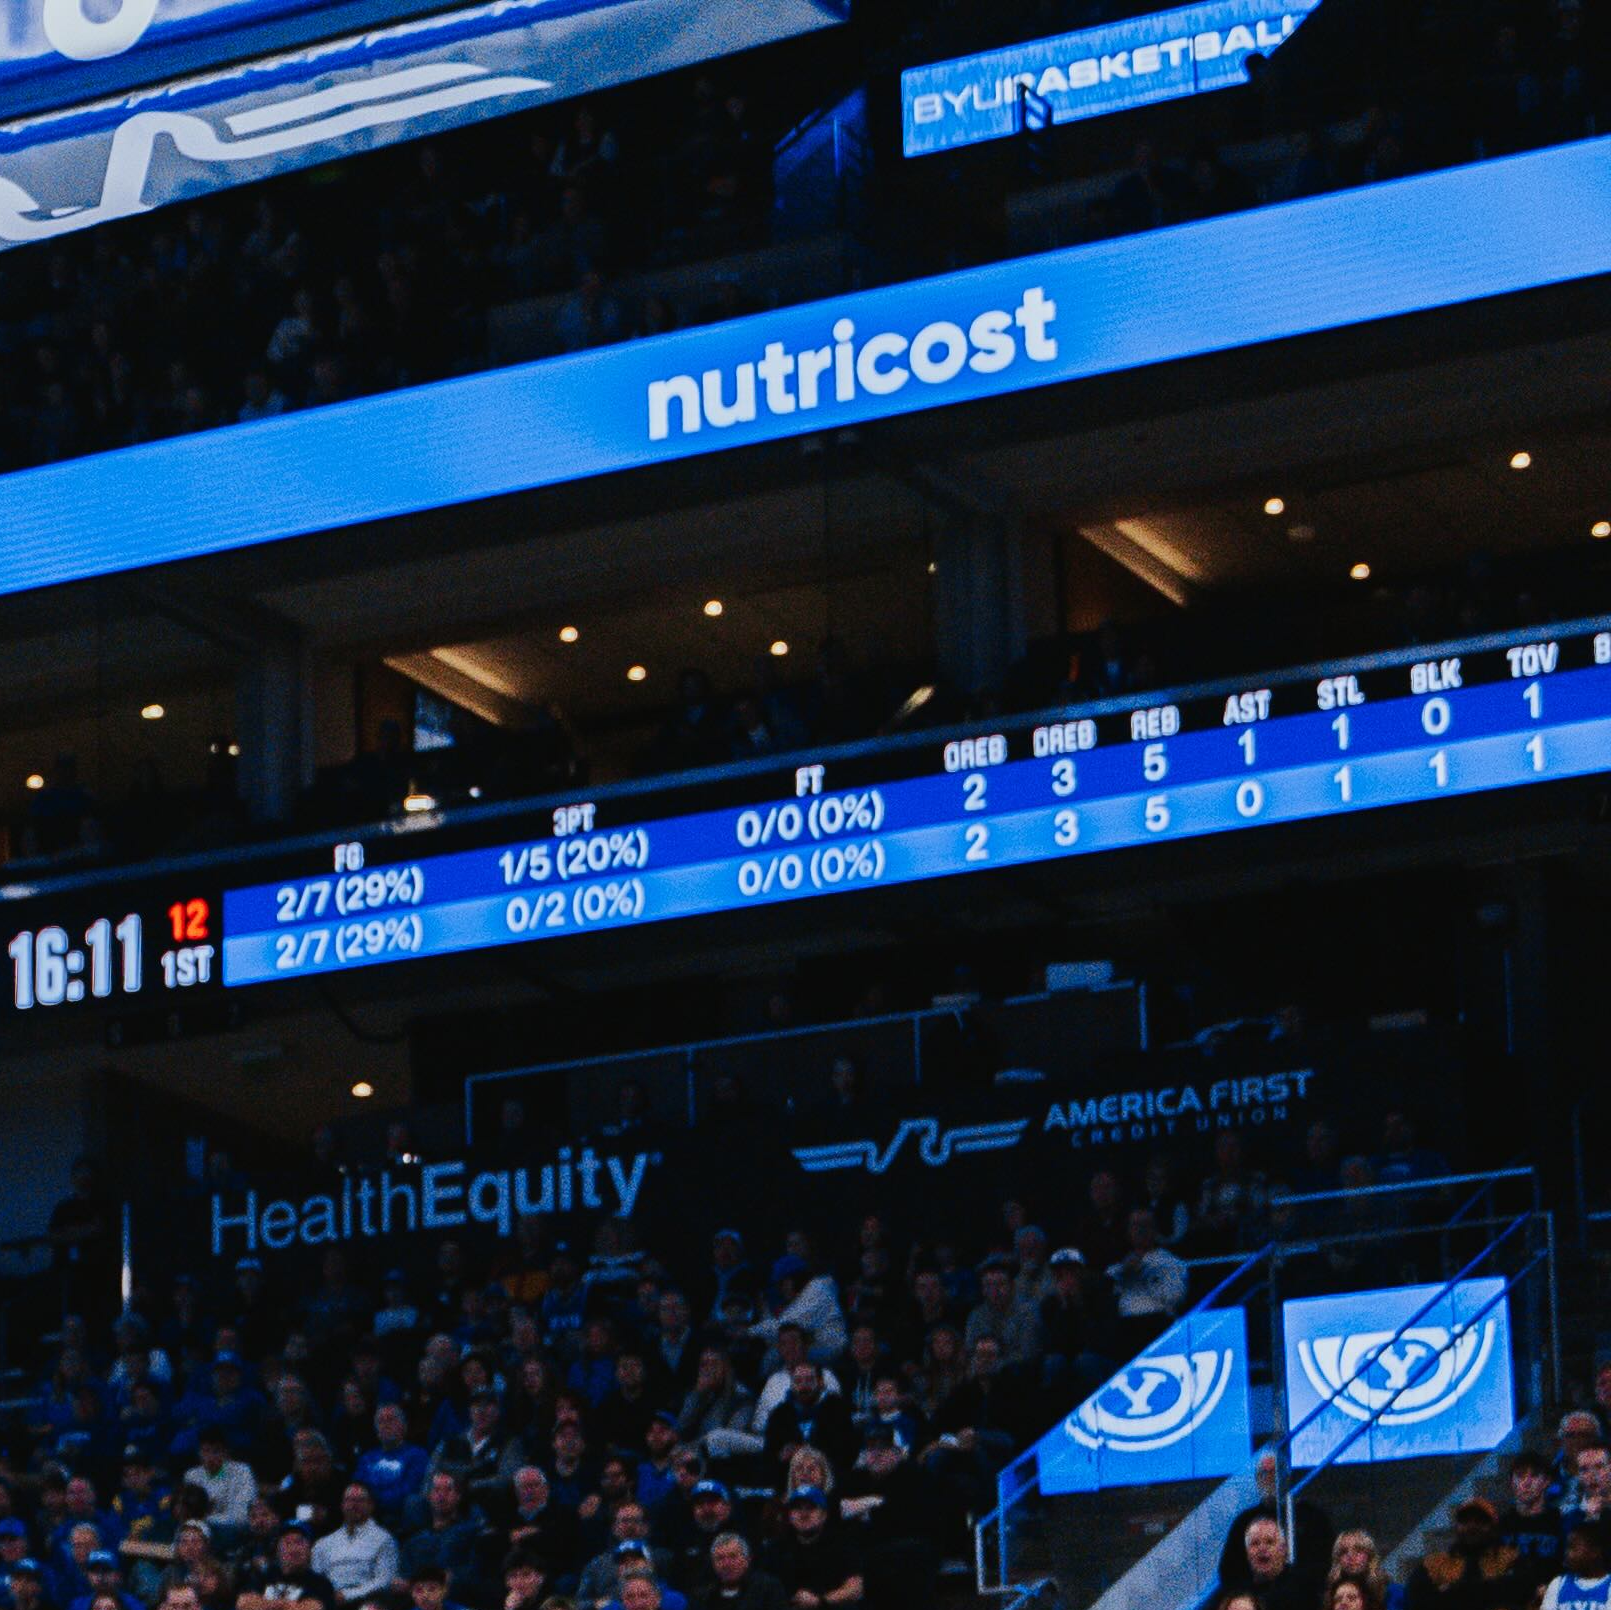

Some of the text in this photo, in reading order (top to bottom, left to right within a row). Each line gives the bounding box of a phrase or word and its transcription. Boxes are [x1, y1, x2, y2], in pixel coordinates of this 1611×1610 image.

[648, 287, 1057, 440] nutricost
[944, 735, 1007, 773] OREB
[1131, 705, 1179, 740] REB
[1223, 689, 1271, 726] AST
[1317, 676, 1365, 712] STL
[1410, 658, 1463, 695] BLK
[1506, 643, 1559, 680] TOV
[277, 682, 1542, 922] 2/7 (29%) 1/5 (20%) 0/0 (0%) 2 3 5 1 1 0 1
[796, 765, 825, 798] FT
[553, 803, 596, 836] 3PT
[276, 735, 1545, 970] 2/7 (29%) 0/2 (0%) 0/0 (0%) 2 3 5 0 1 1 1
[334, 842, 365, 871] FG
[167, 899, 210, 942] 12
[9, 912, 143, 1009] 16:11
[161, 944, 216, 989] 1ST
[1043, 1068, 1315, 1132] AMERICA FIRST
[1071, 1105, 1289, 1149] CREDIT UNION
[211, 1146, 649, 1256] HealthEquity
[1110, 1374, 1167, 1416] Y
